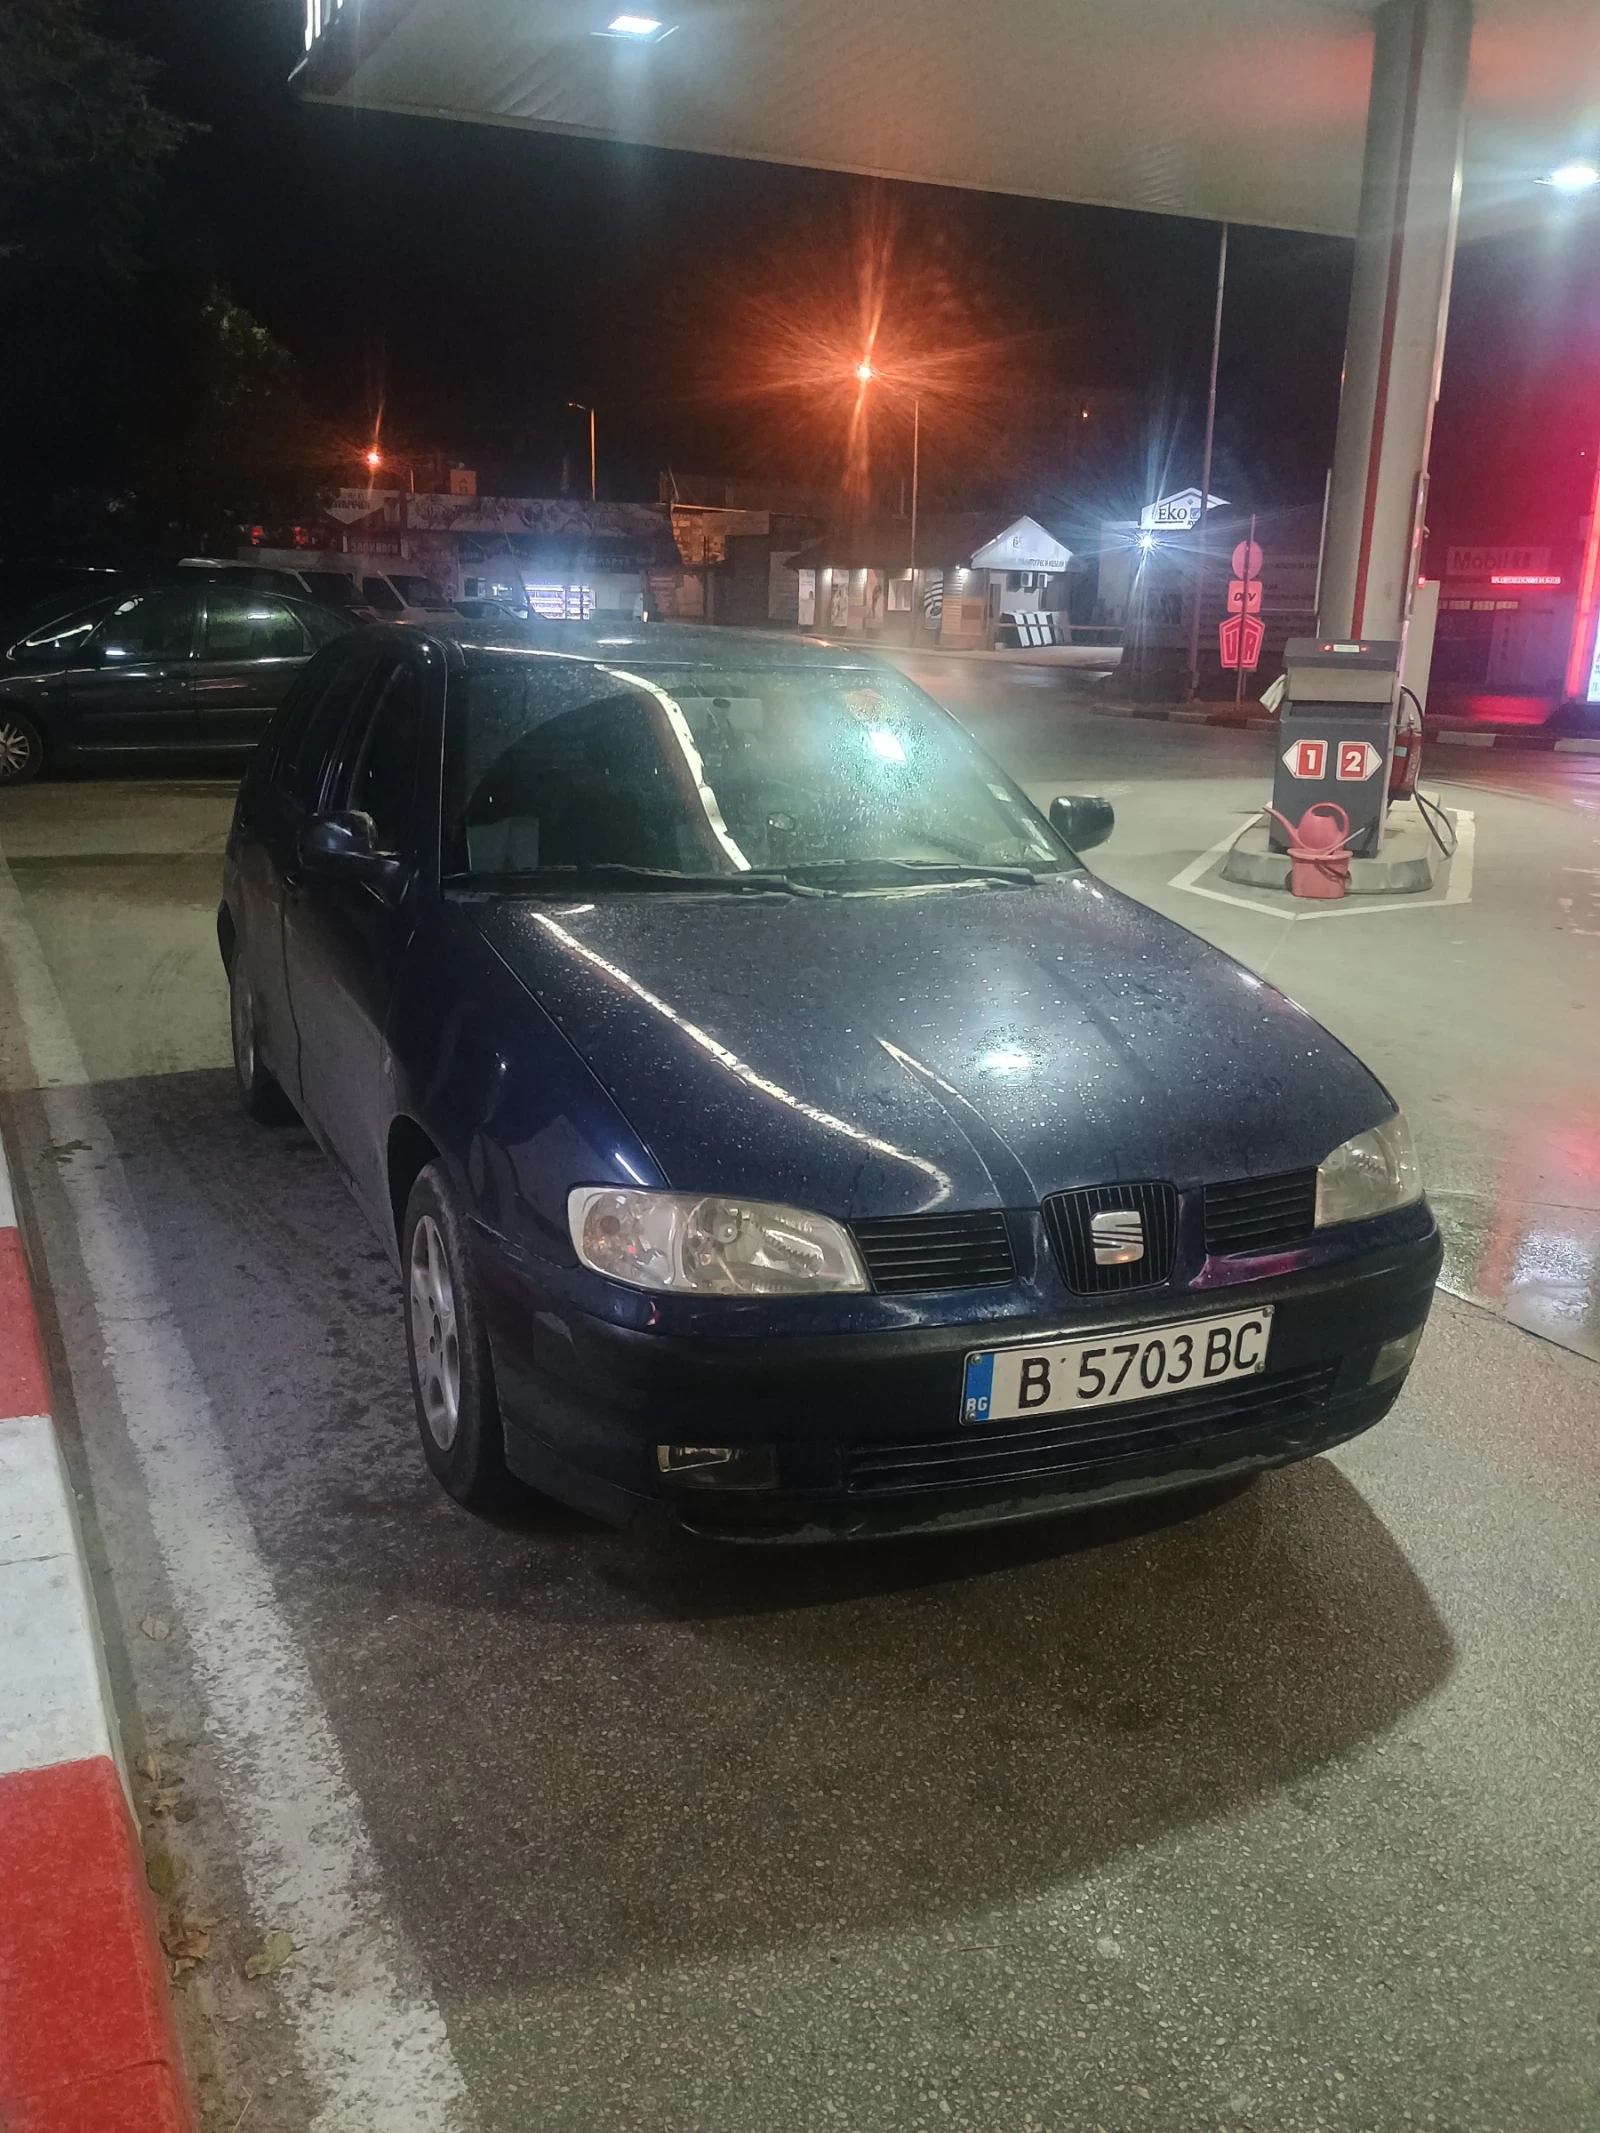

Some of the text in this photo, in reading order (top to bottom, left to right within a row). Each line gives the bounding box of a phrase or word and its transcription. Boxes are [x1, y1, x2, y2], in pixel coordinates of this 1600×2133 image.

[1453, 550, 1510, 570] Mobil
[1233, 592, 1257, 602] DV
[1306, 749, 1317, 770] 1
[1344, 750, 1362, 772] 2
[1018, 1320, 1263, 1410] B 5703 BC
[966, 1396, 989, 1413] BG
